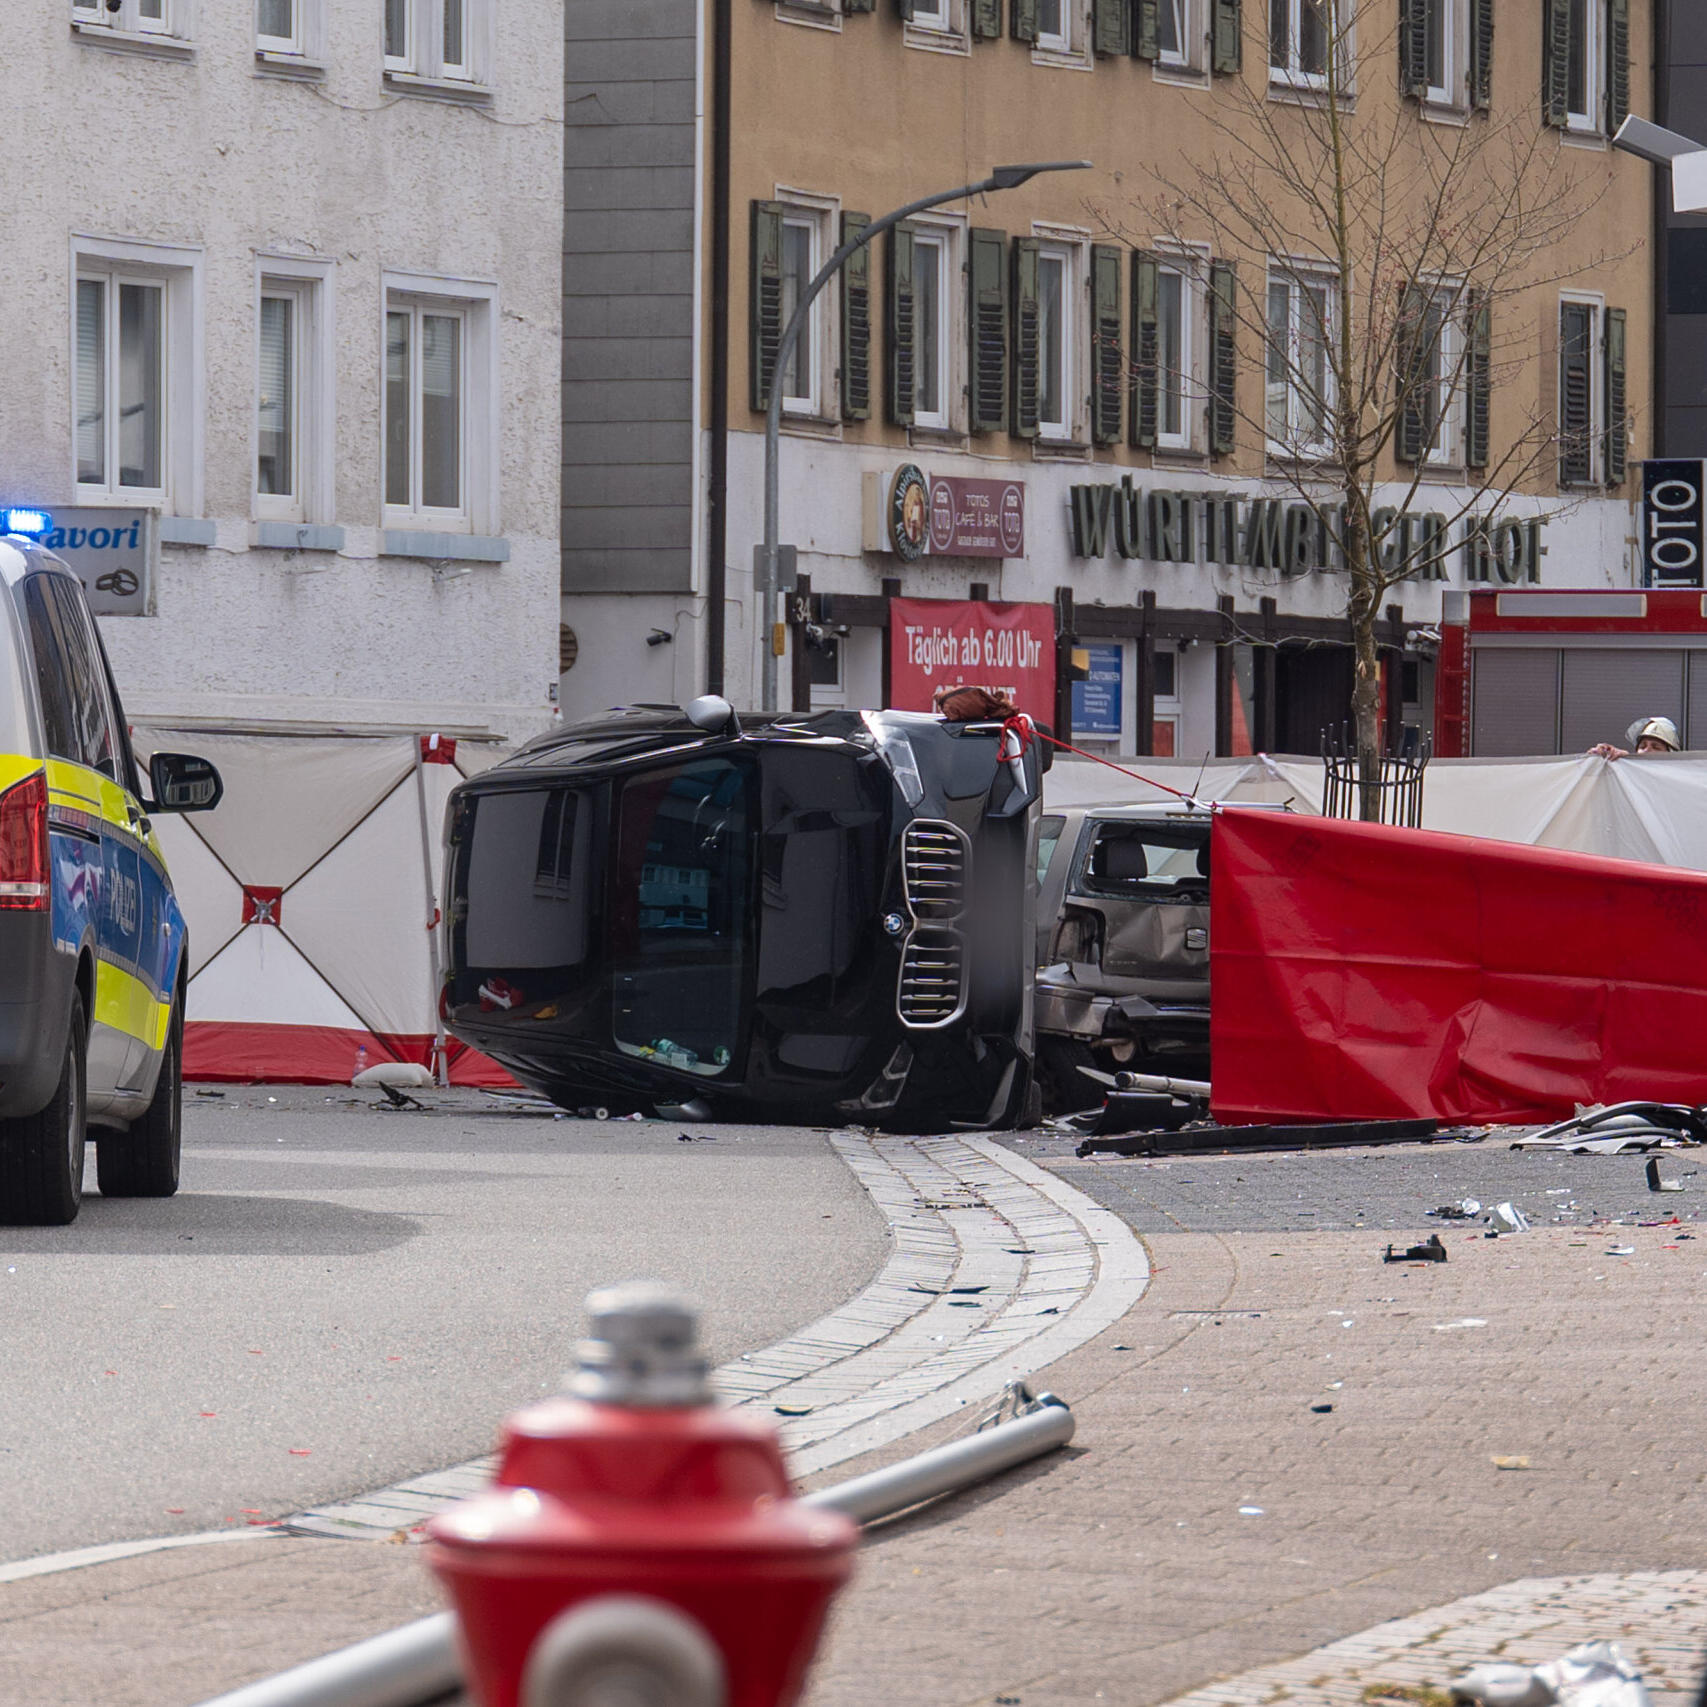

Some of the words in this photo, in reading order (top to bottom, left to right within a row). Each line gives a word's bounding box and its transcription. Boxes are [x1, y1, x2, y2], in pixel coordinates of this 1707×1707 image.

[44, 519, 140, 549] avori
[984, 512, 999, 528] BAR
[1466, 512, 1549, 584] HOF
[796, 597, 812, 623] 34
[905, 625, 958, 675] Täglich
[961, 628, 981, 667] ab
[984, 628, 1014, 668] 6.00
[1016, 630, 1042, 668] Uhr
